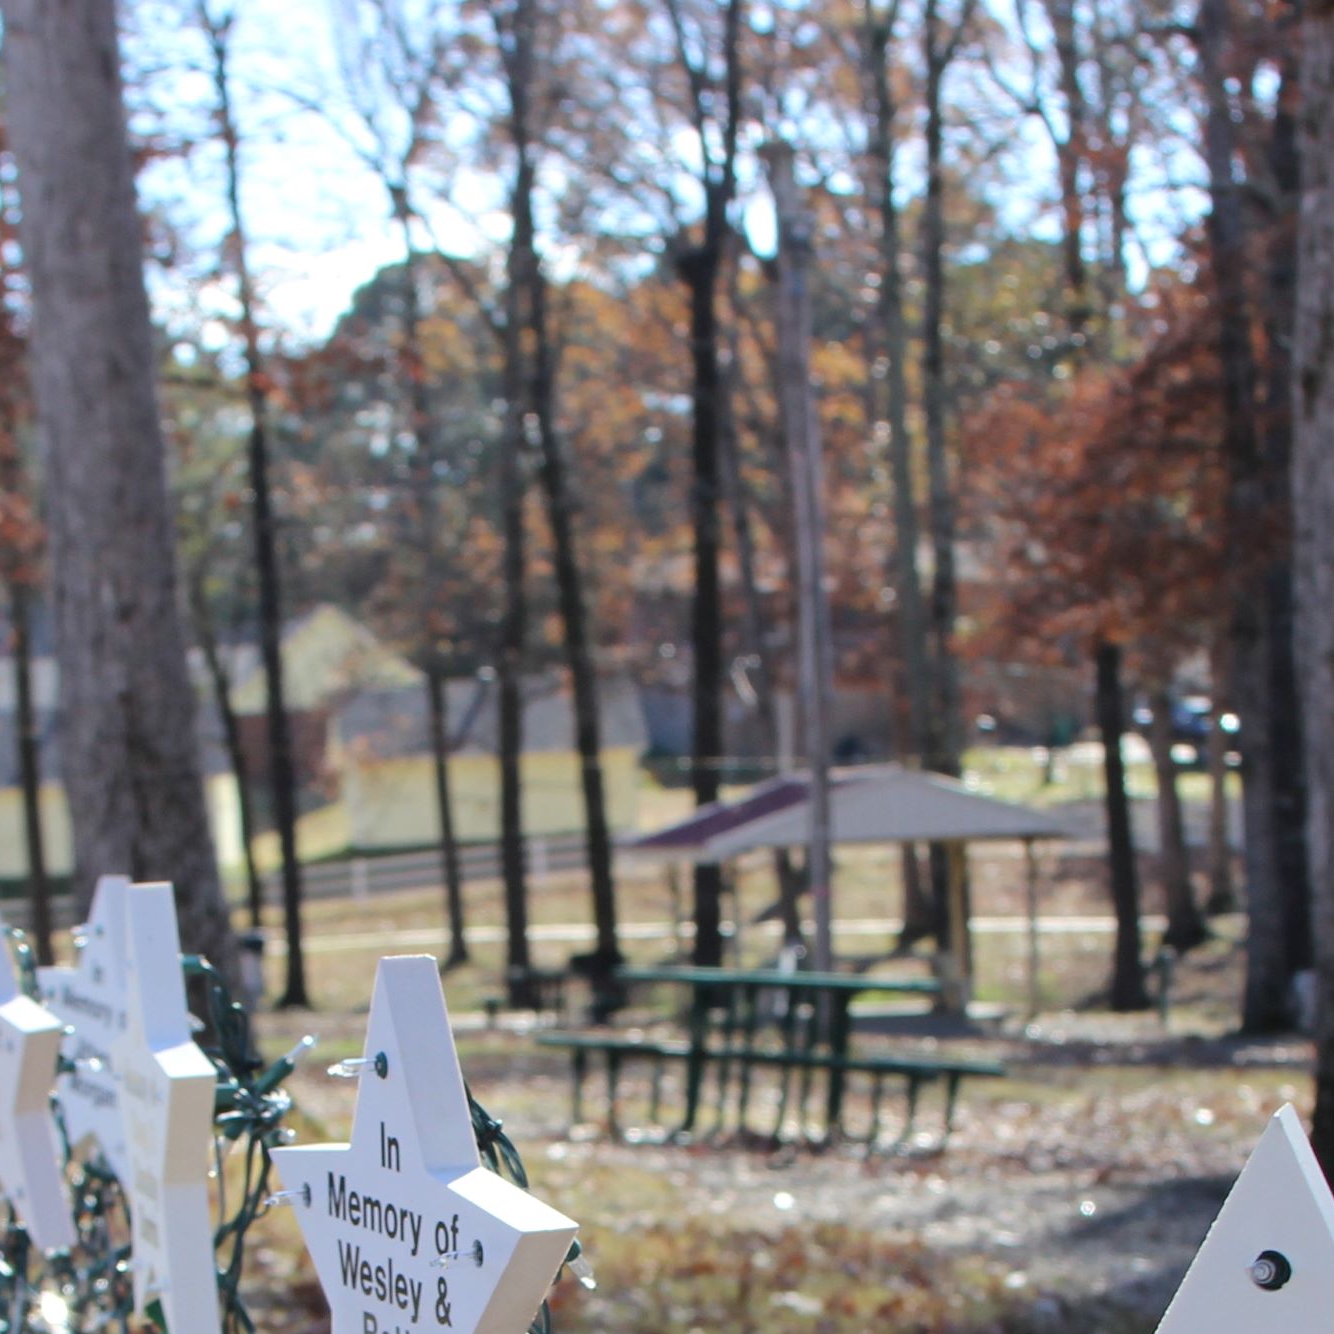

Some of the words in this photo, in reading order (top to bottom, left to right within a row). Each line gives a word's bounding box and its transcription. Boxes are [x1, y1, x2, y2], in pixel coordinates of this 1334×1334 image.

[380, 1121, 400, 1172] In
[328, 1171, 422, 1256] Memory
[435, 1213, 459, 1259] of
[338, 1239, 422, 1323] Wesley
[435, 1276, 452, 1327] &
